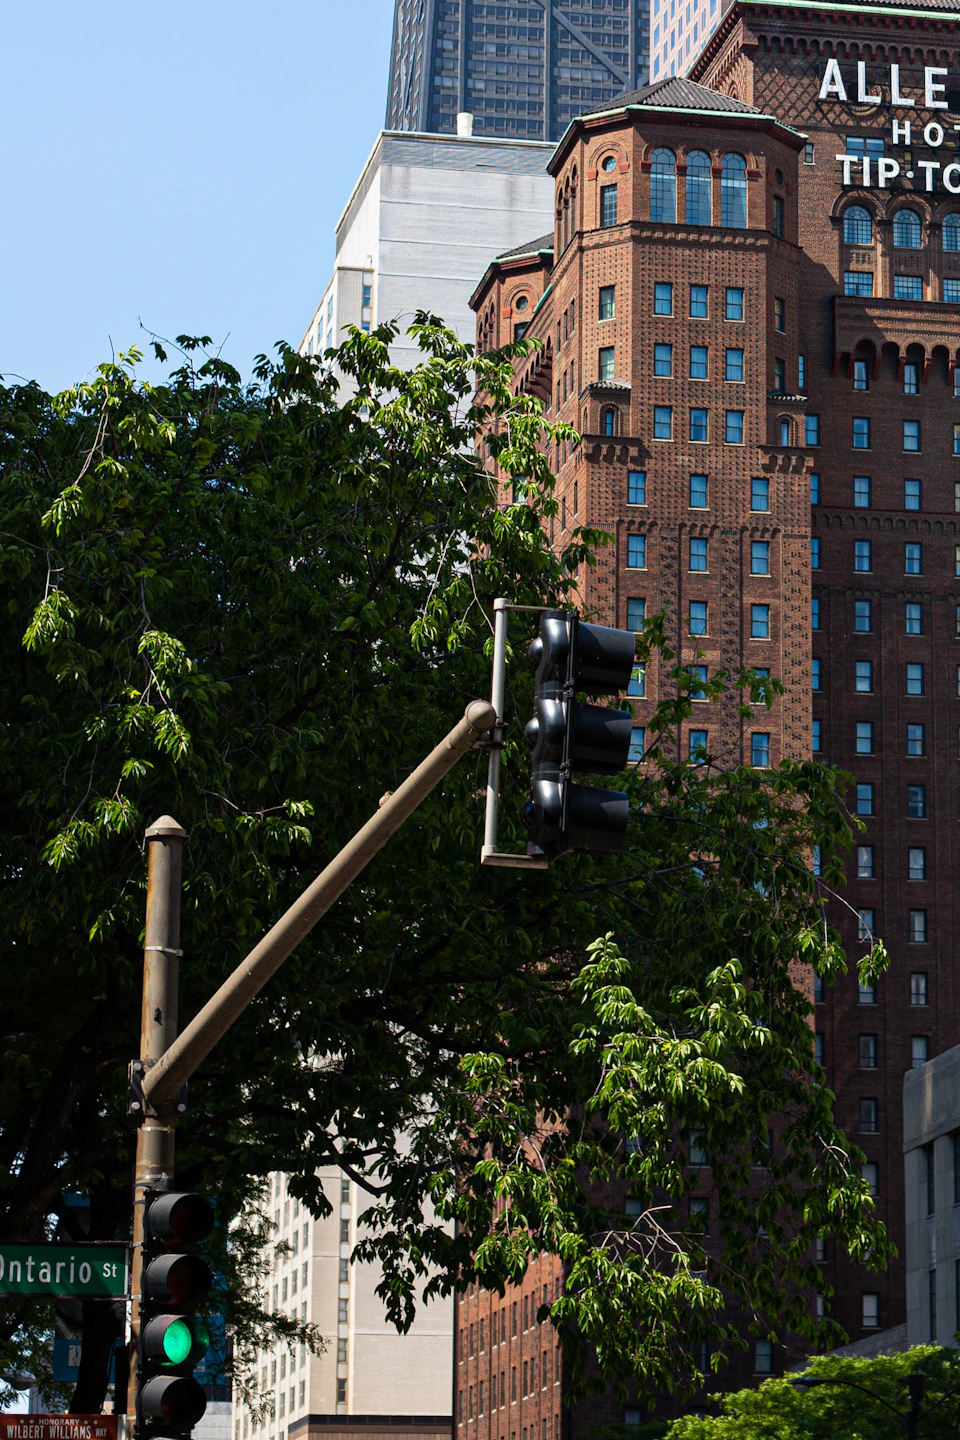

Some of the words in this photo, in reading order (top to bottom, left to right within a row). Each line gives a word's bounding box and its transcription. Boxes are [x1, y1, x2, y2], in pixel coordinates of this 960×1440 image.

[102, 1262, 118, 1278] St
[39, 1418, 80, 1426] HONORARY
[6, 1425, 44, 1439] WILBERT
[49, 1425, 91, 1439] WILLIAMS
[95, 1428, 108, 1437] WAY
